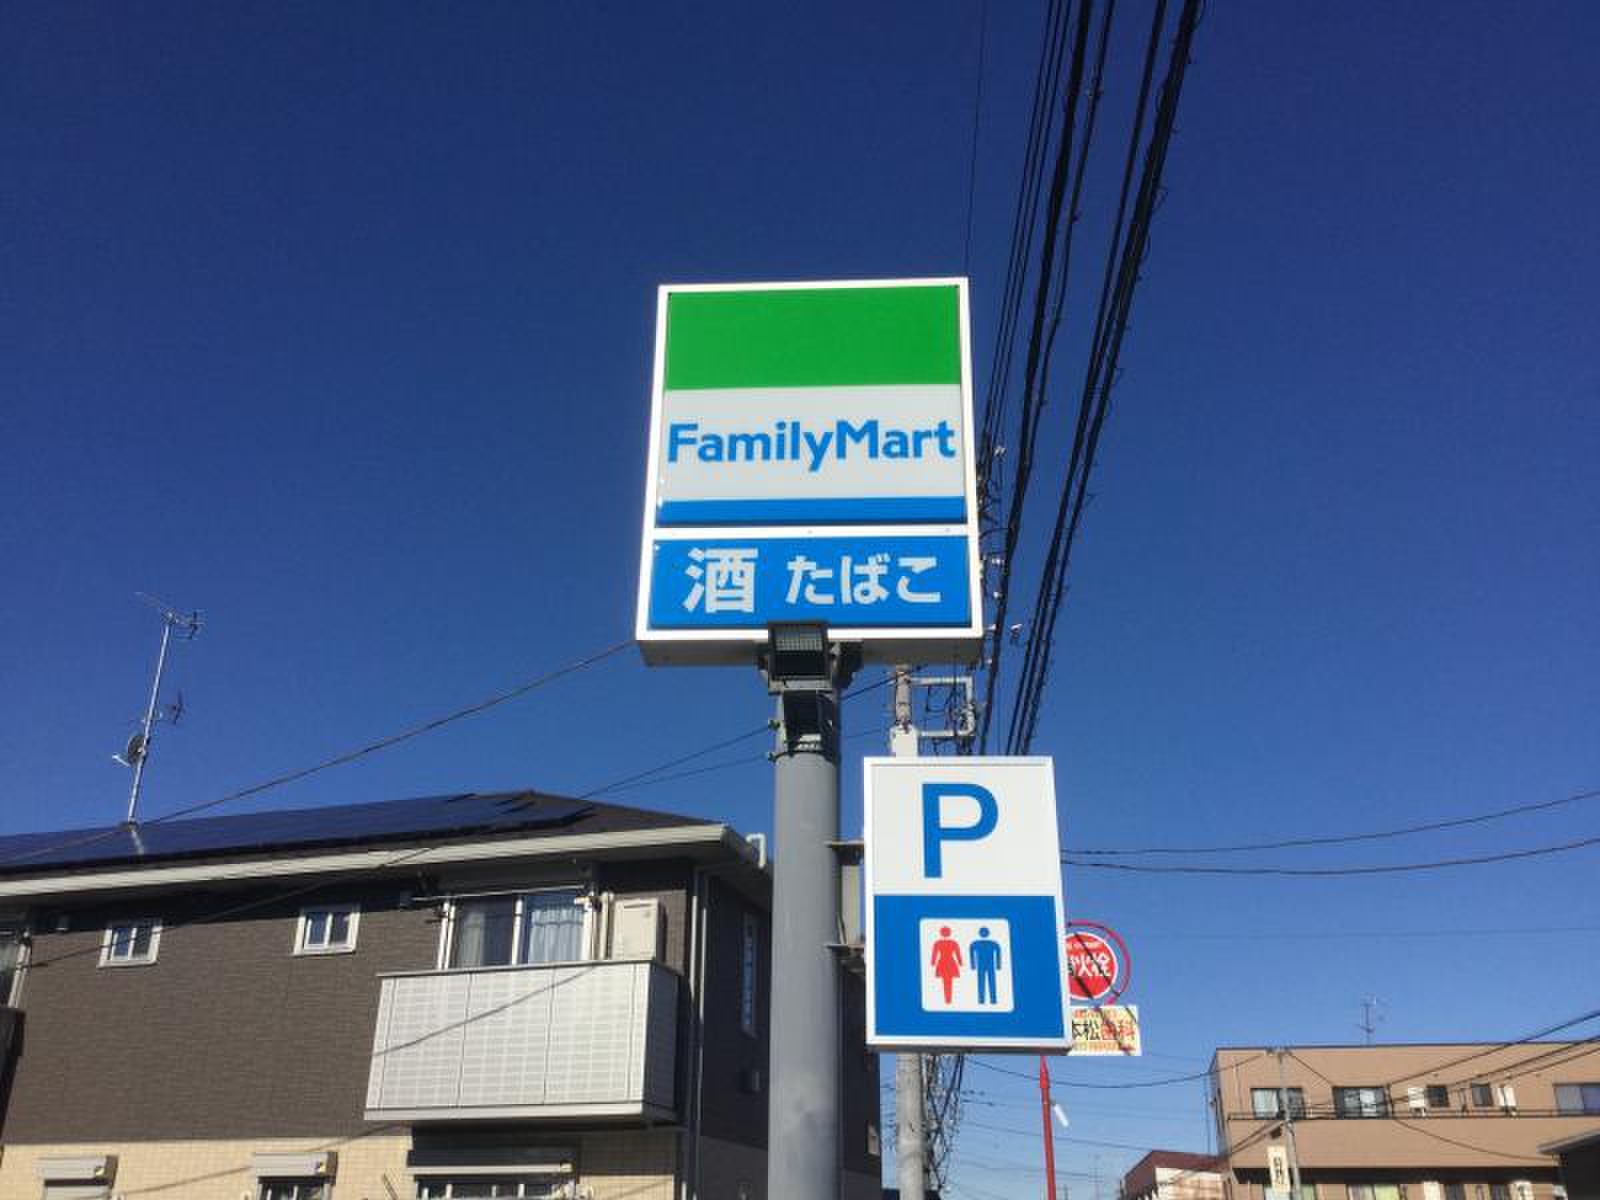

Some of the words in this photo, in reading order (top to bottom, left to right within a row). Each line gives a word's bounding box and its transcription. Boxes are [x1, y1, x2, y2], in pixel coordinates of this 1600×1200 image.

[668, 420, 955, 472] FamilyMart
[683, 547, 758, 613] 酒
[785, 552, 941, 605] たばこ
[922, 783, 998, 878] P
